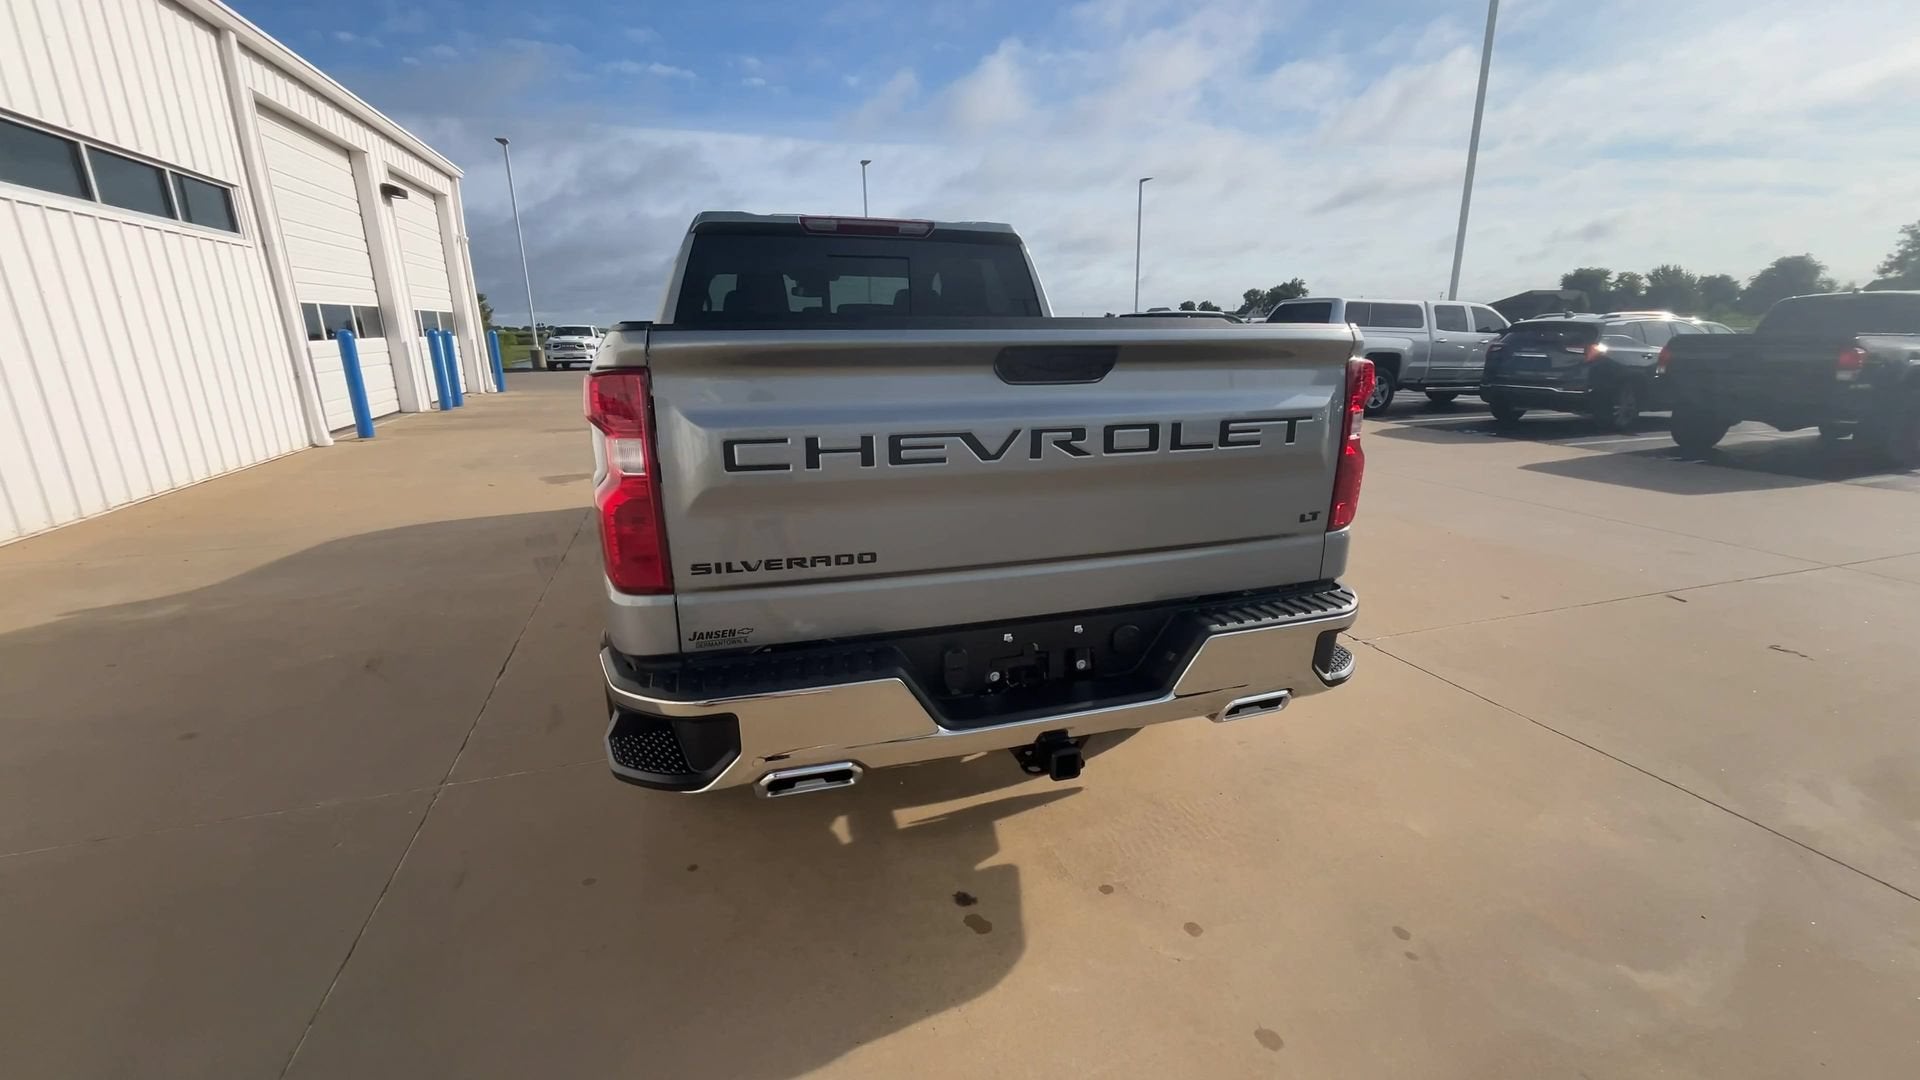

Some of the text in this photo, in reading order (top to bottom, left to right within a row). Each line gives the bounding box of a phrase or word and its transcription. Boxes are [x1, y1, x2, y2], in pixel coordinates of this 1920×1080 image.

[722, 416, 1313, 473] CHEVROLET
[1299, 511, 1321, 523] LT
[690, 552, 877, 576] SILVERADO
[688, 629, 737, 642] JANSEN
